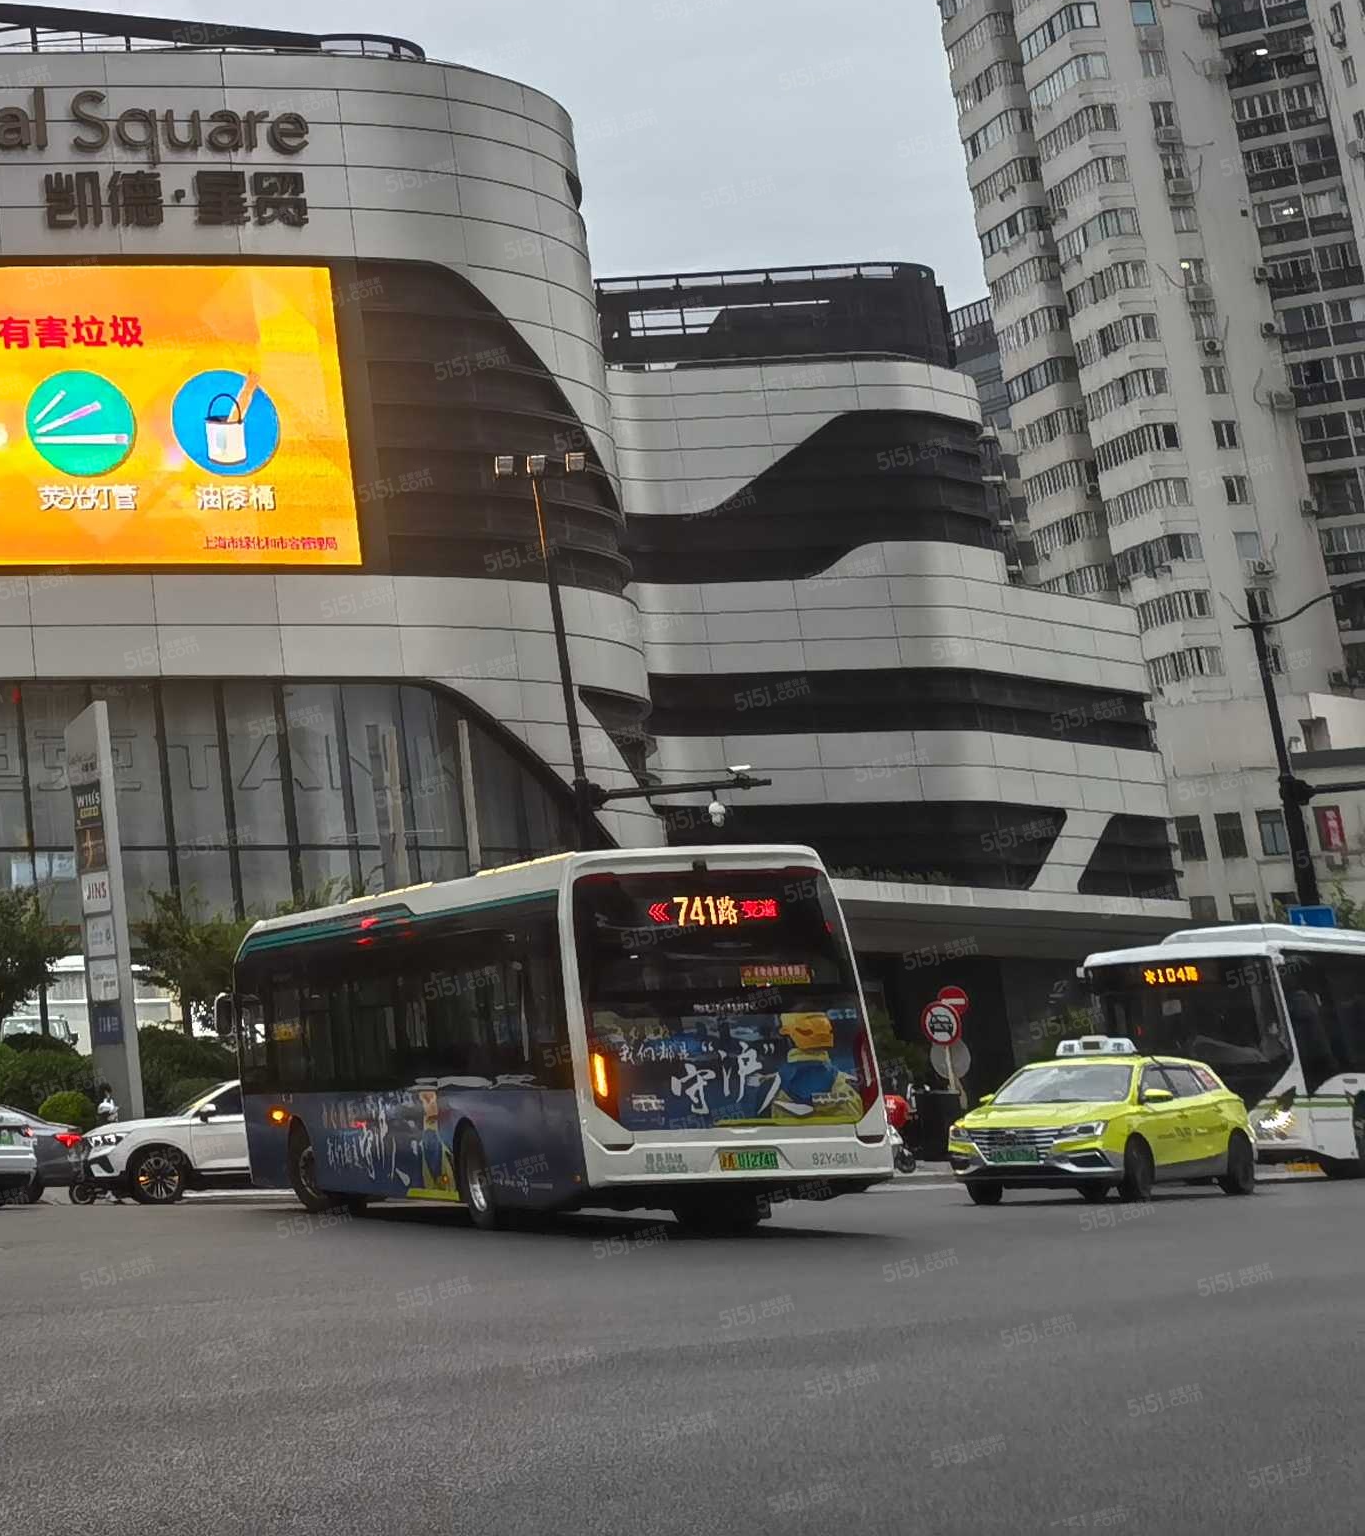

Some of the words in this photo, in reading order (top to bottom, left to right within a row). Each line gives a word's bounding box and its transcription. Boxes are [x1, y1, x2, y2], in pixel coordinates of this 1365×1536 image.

[72, 90, 309, 168] Square
[37, 484, 139, 511] 荧光灯管
[195, 483, 276, 512] 油漆桶
[85, 881, 107, 900] JINS
[672, 895, 739, 927] 741路
